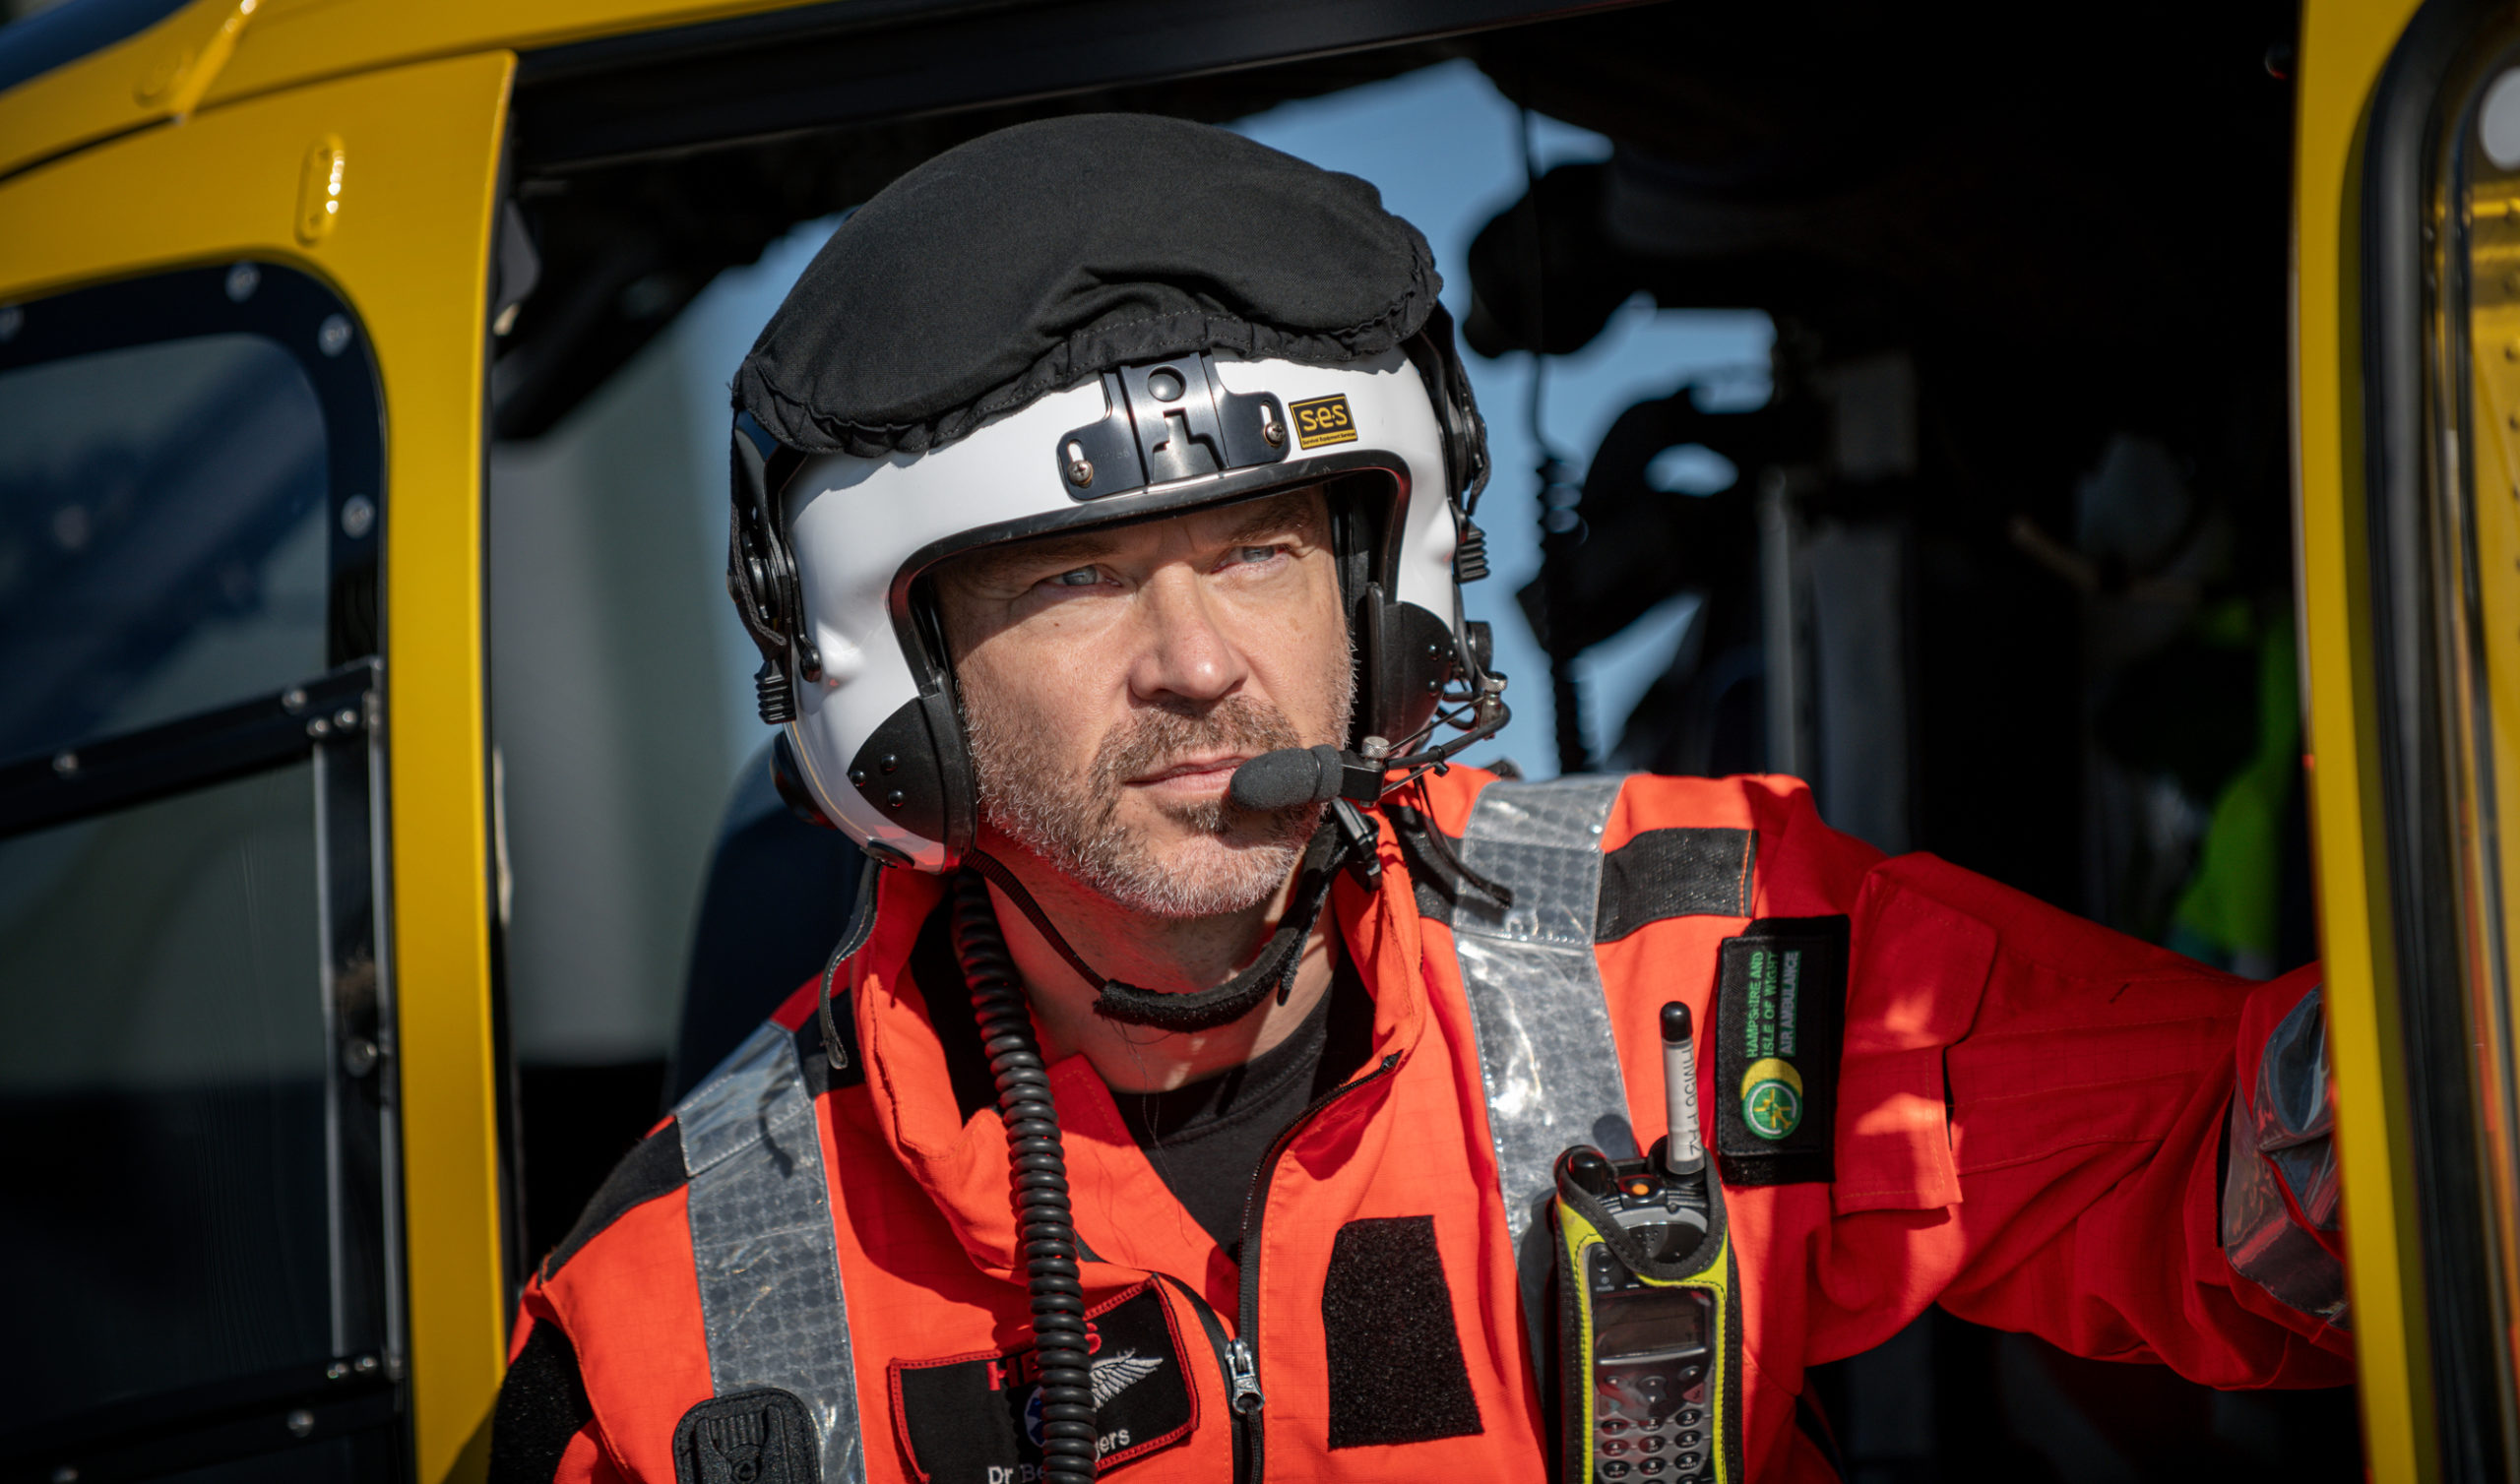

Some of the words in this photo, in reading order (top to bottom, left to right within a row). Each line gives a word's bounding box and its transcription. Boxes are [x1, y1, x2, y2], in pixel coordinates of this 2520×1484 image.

[1749, 951, 1764, 978] AND
[1763, 952, 1779, 997] WIGHT
[1780, 952, 1799, 1029] AMBULANCE
[1746, 981, 1761, 1058] HAMPSHIRE
[1763, 1000, 1776, 1020] OF
[1762, 1023, 1775, 1056] ISLE
[1780, 1031, 1795, 1055] AIR
[987, 1465, 1014, 1484] Dr
